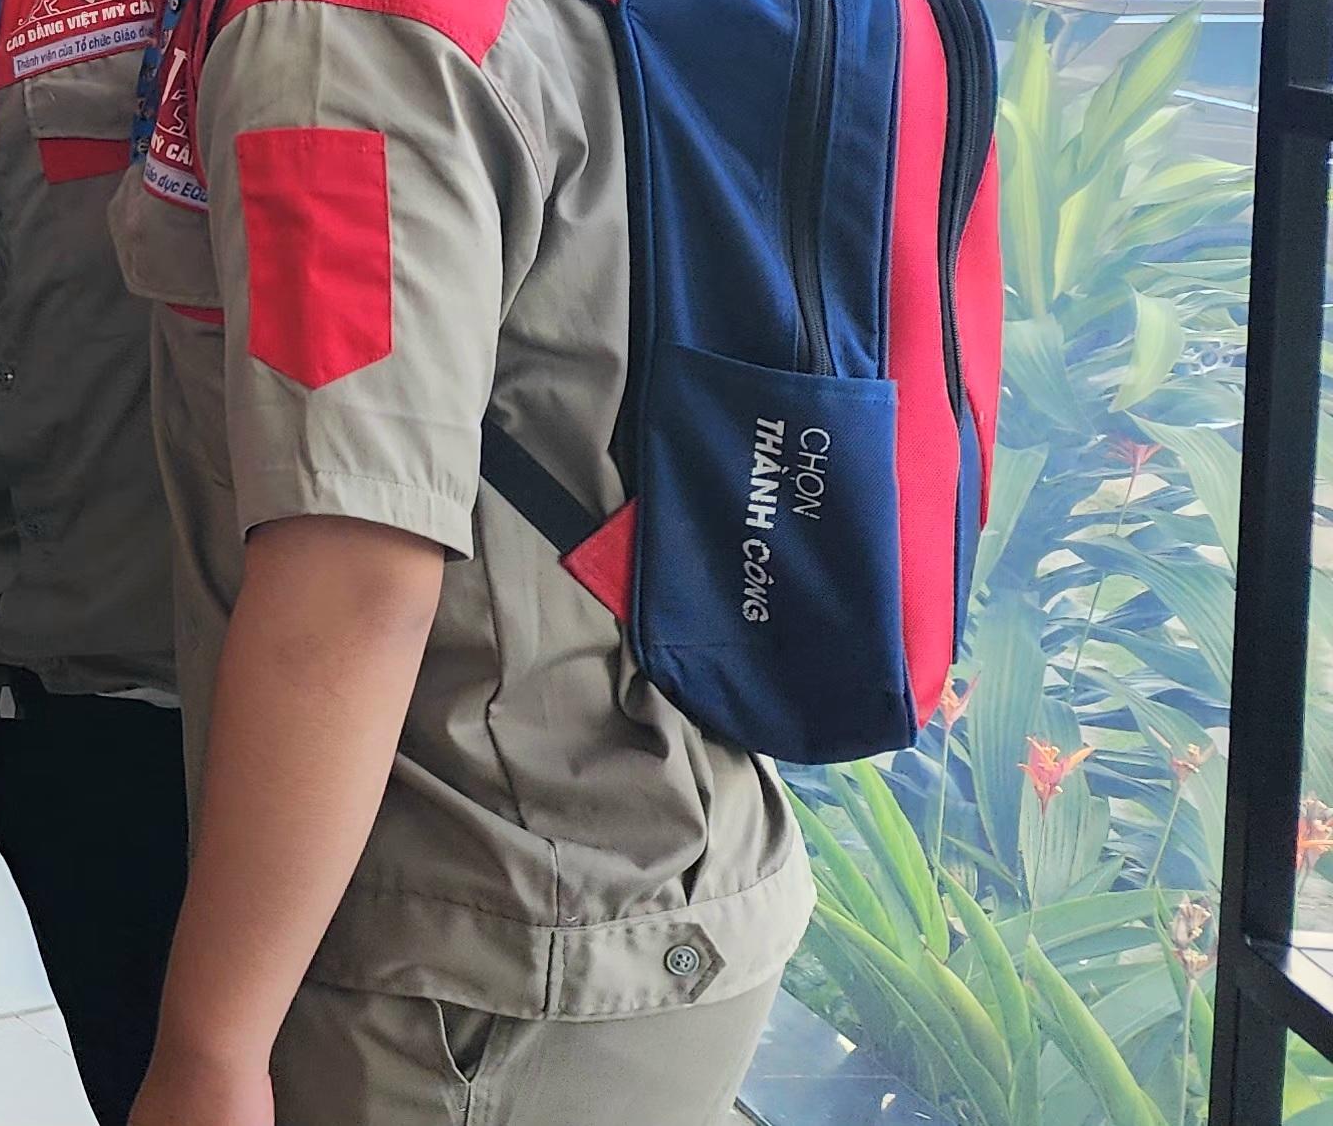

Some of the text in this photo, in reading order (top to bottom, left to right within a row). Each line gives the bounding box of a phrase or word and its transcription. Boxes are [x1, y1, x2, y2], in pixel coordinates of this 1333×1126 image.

[6, 34, 26, 52] CAO
[67, 12, 99, 30] VIỆT
[742, 418, 789, 622] THÀNH CÔNG
[789, 427, 831, 520] CHỌN
